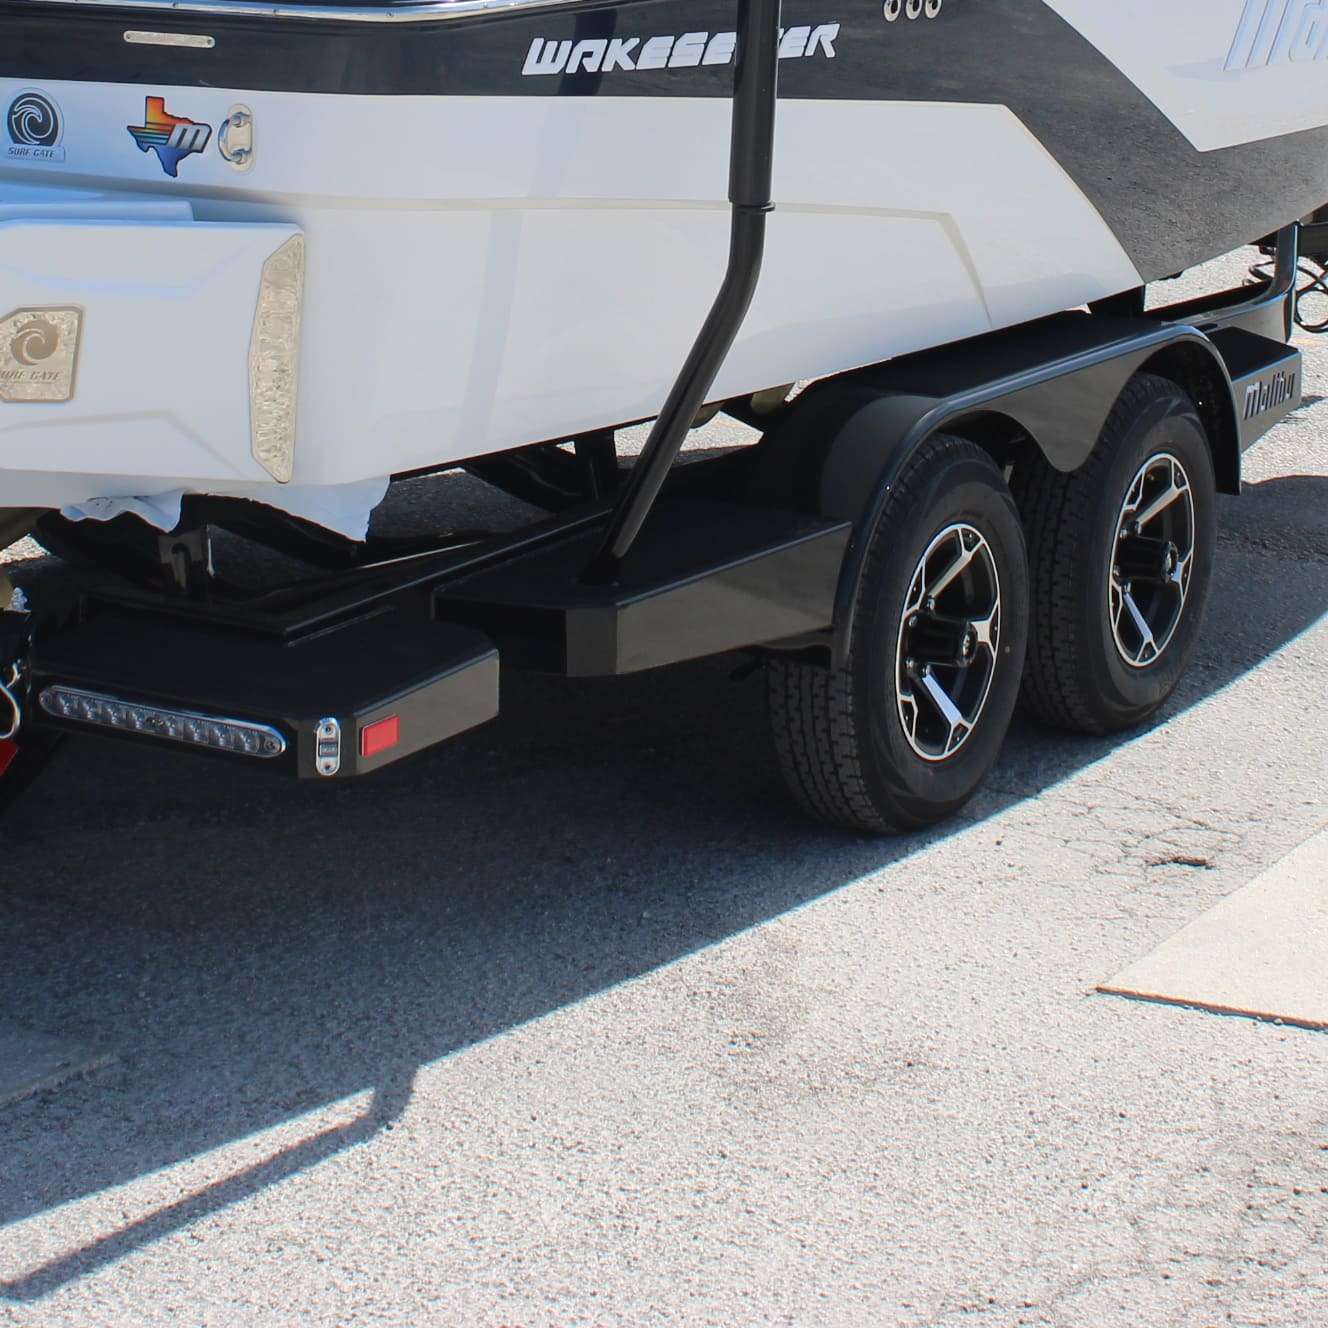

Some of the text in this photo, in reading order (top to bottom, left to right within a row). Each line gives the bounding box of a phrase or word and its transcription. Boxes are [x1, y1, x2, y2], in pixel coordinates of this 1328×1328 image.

[521, 23, 841, 76] WAKESEER
[8, 146, 55, 158] SURF GATE
[30, 370, 60, 381] GATE
